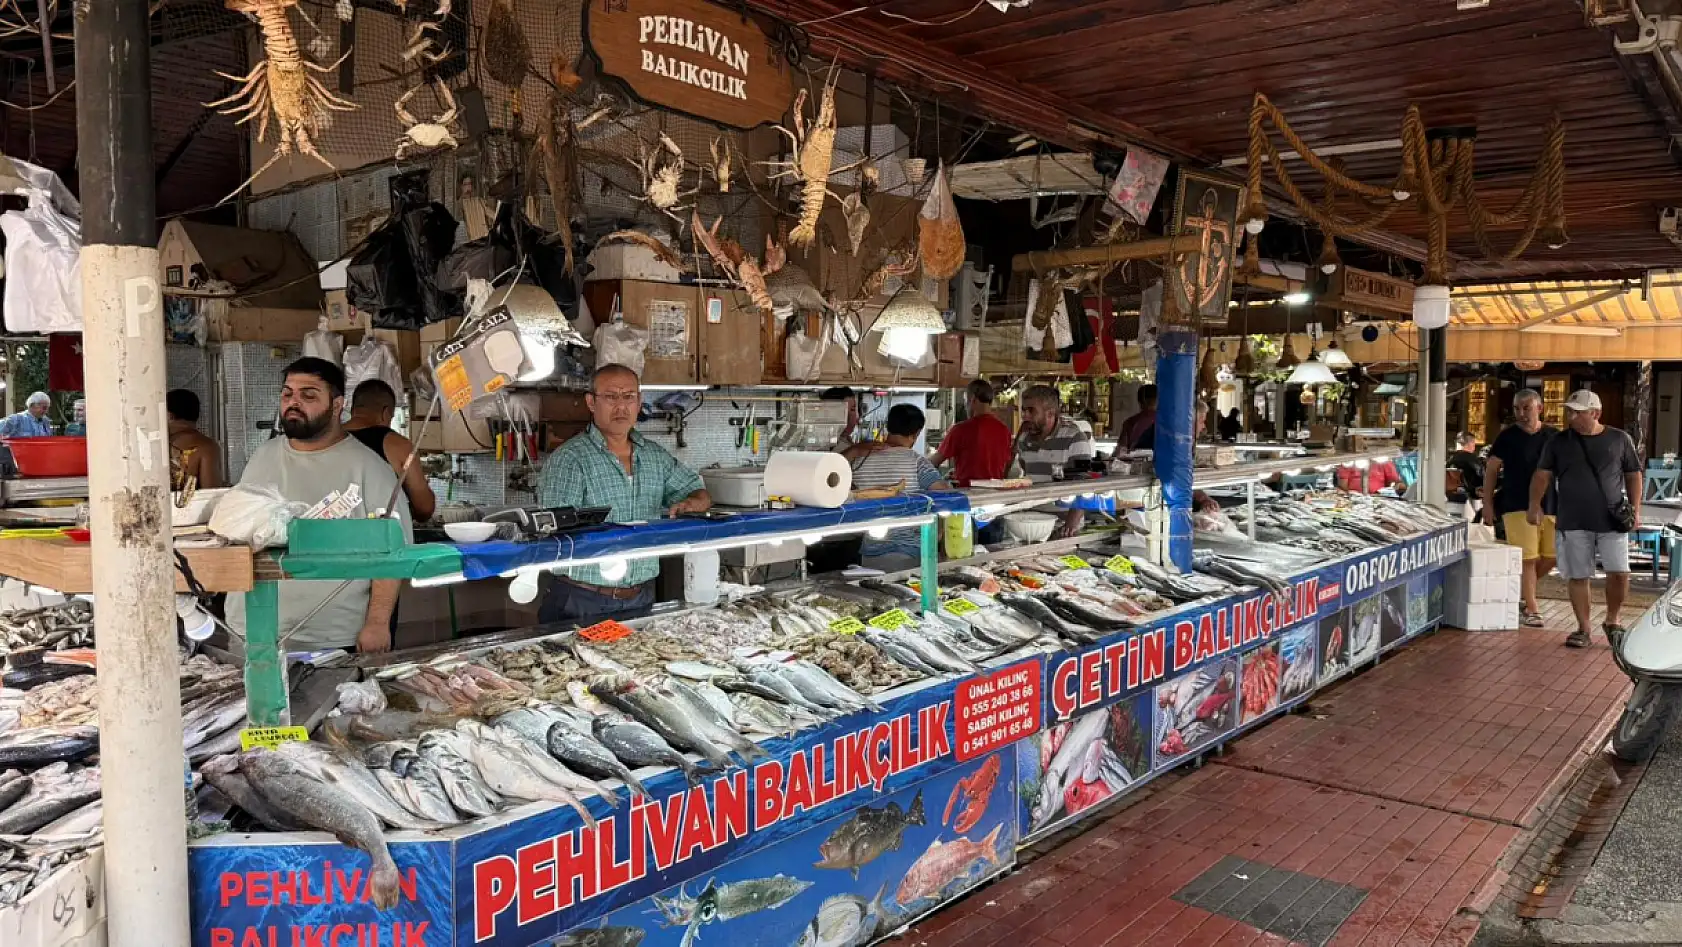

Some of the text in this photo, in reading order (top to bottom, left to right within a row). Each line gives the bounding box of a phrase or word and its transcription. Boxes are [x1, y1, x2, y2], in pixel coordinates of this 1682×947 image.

[641, 50, 747, 100] BALIKCILIK
[1346, 527, 1466, 595] ORFOZ BALIKÇILIK
[963, 706, 969, 719] 0
[972, 700, 989, 716] 555
[991, 693, 1008, 709] 240
[1022, 684, 1033, 698] 66
[969, 670, 1029, 699] ÜNAL KILINÇ
[1000, 702, 1029, 721] KILINÇ
[963, 717, 1033, 753] 0 541 901 65 48
[474, 701, 950, 942] PEHLİVAN BALIKÇILIK
